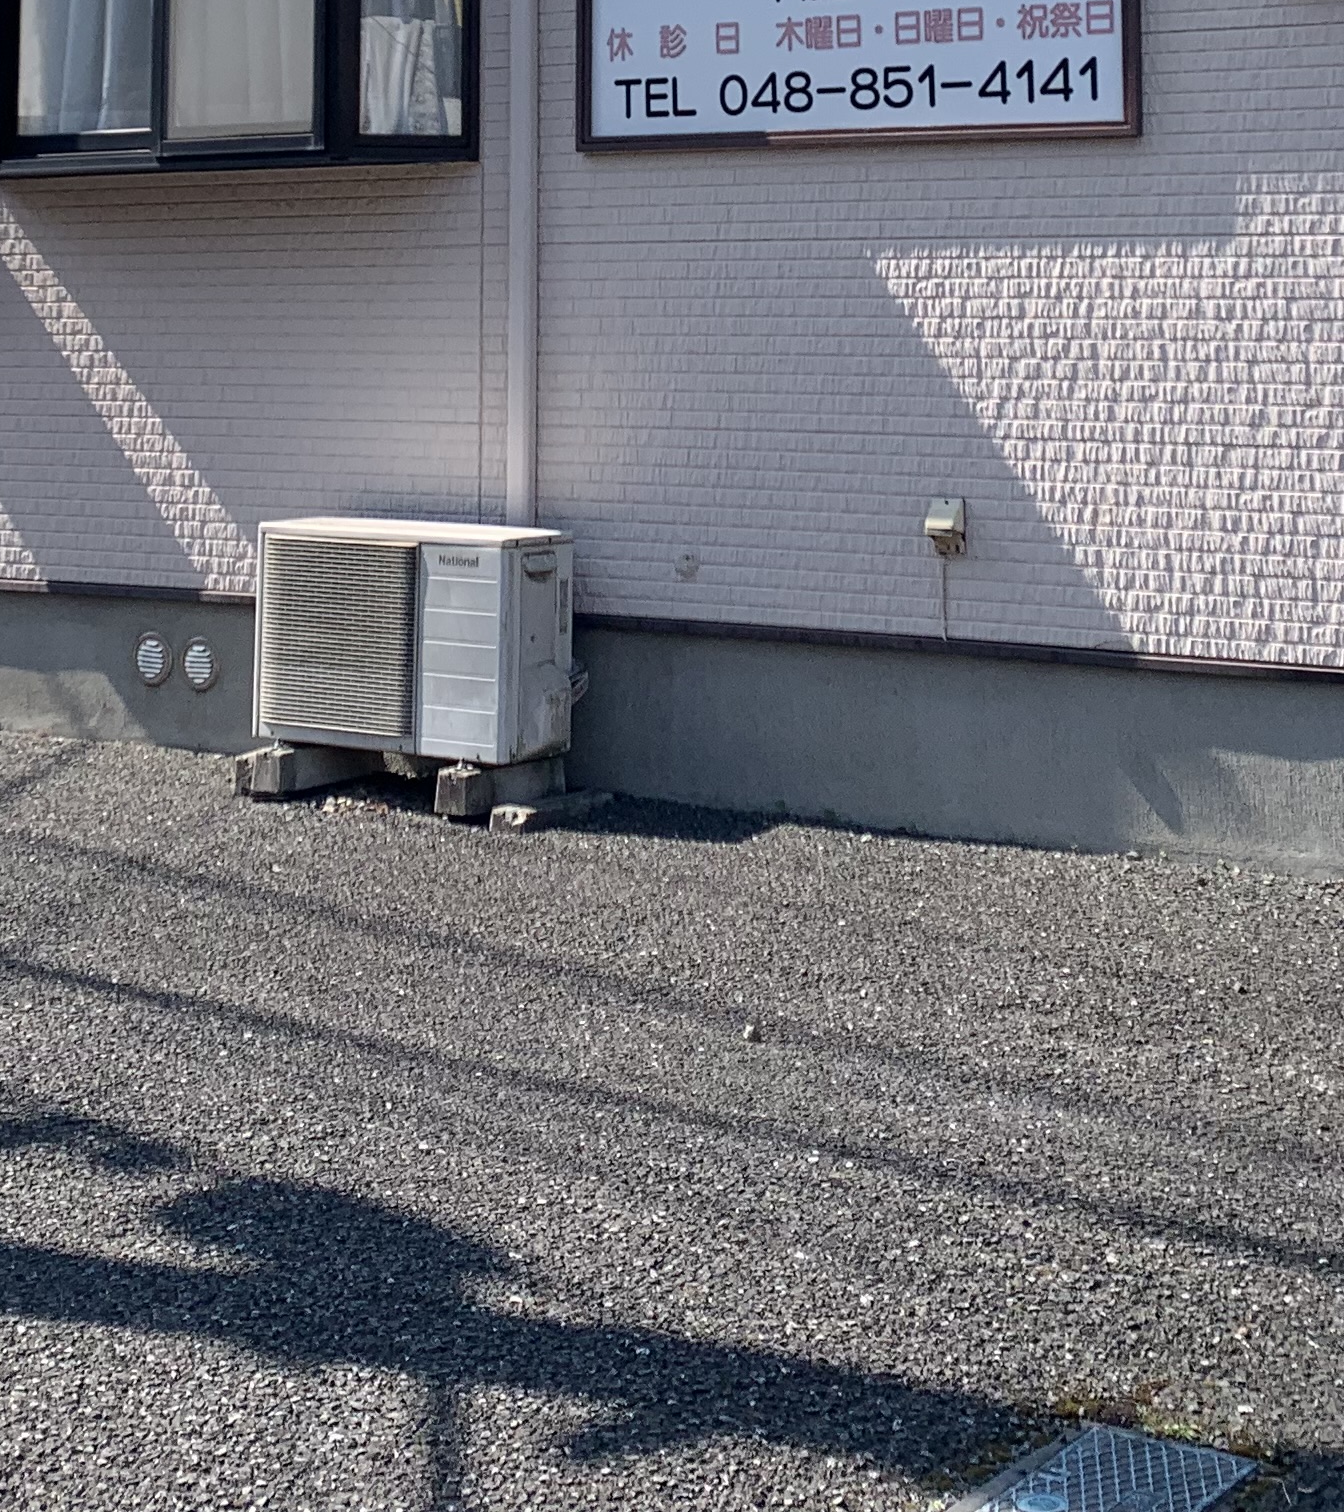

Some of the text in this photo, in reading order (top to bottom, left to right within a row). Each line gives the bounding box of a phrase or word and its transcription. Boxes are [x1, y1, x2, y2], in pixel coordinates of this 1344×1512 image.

[614, 55, 1101, 119] TEL 048-851-4141
[439, 555, 479, 568] National
